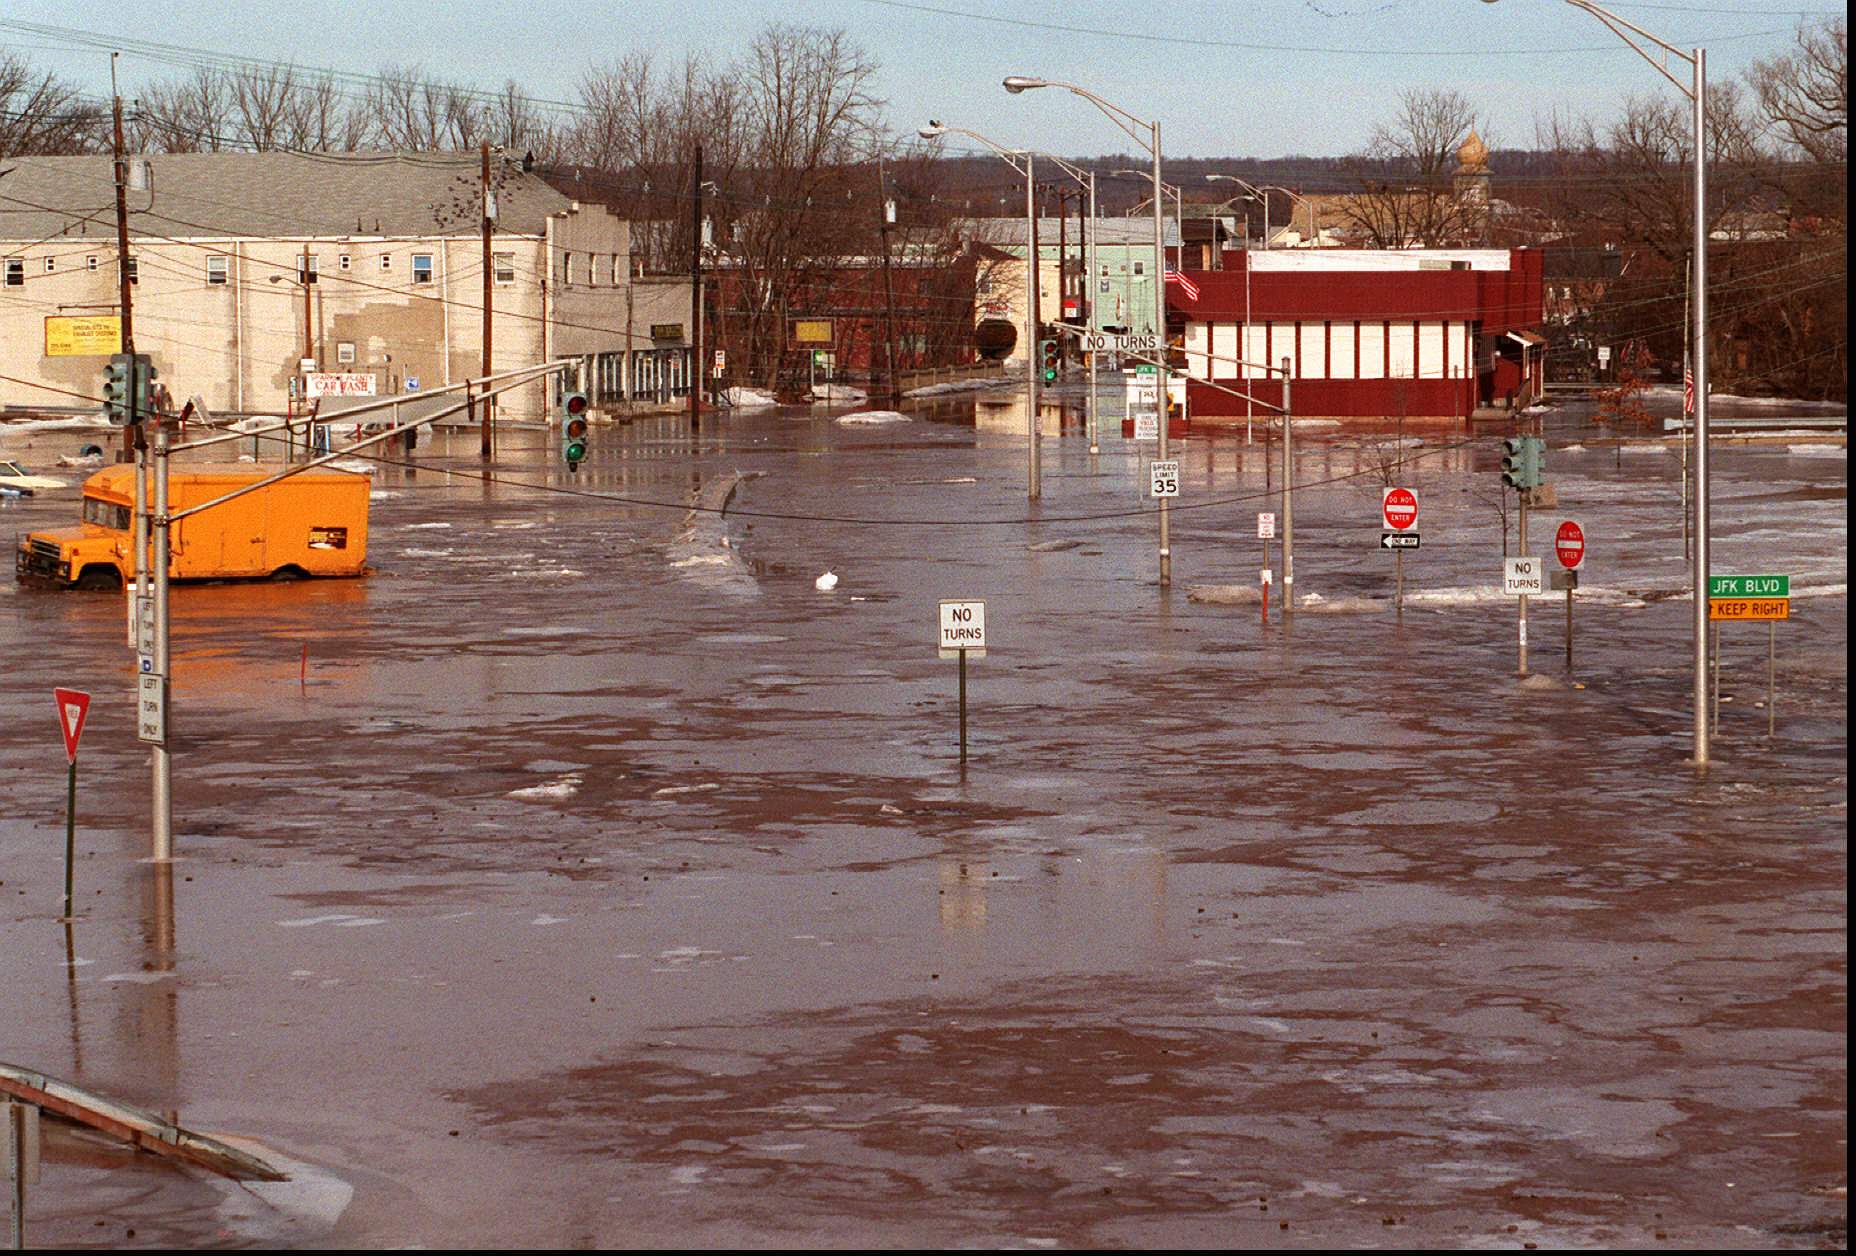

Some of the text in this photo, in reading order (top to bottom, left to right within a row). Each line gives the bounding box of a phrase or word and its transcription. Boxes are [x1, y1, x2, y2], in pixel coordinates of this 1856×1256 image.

[1087, 335, 1156, 349] NO TURNS
[315, 381, 368, 392] CAR WASH
[1153, 463, 1177, 471] SPEED
[1154, 480, 1177, 493] 35
[1388, 496, 1413, 504] DO NOT
[1391, 514, 1410, 522] ENTER
[1515, 562, 1531, 574] NO
[1508, 579, 1540, 589] TURNS
[1713, 579, 1780, 594] JFK BLVD
[952, 608, 972, 622] NO
[1718, 602, 1785, 616] KEEP RIGHT
[943, 627, 982, 641] TURNS
[144, 679, 157, 689] LEFT
[144, 700, 158, 712] TURN
